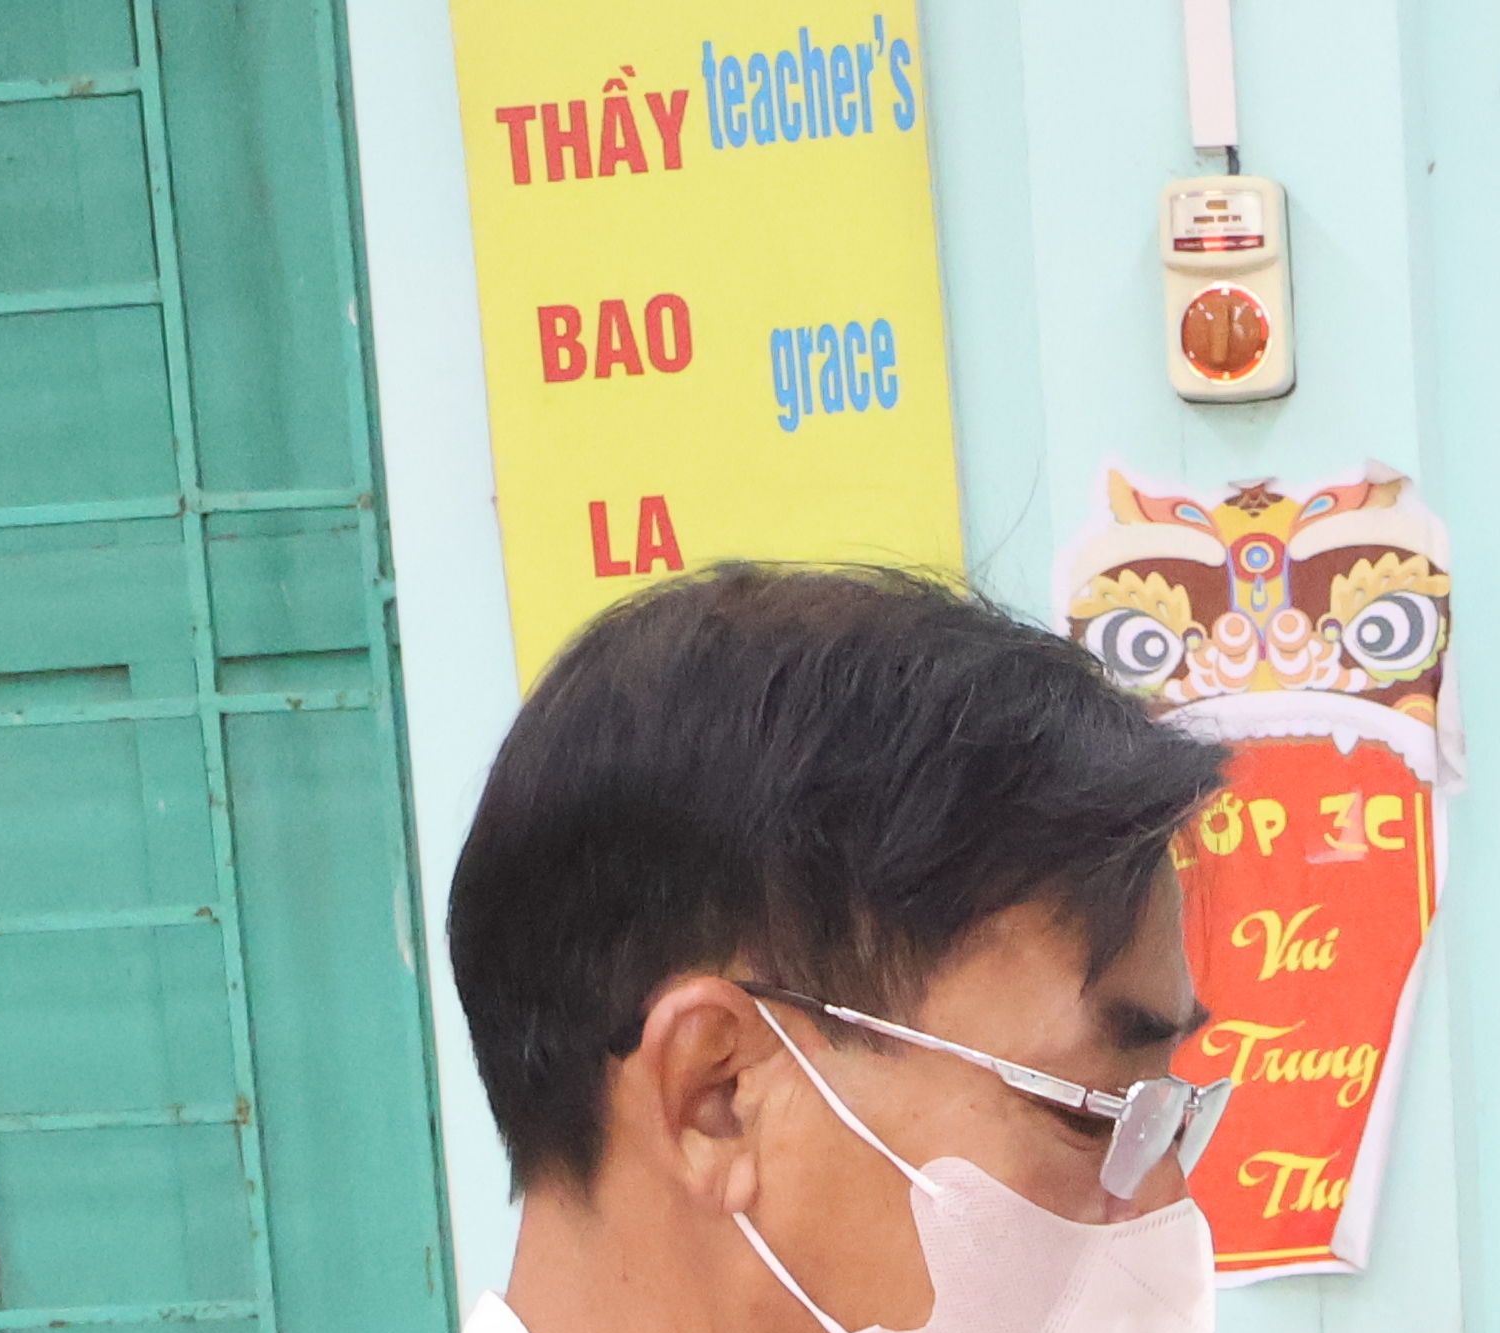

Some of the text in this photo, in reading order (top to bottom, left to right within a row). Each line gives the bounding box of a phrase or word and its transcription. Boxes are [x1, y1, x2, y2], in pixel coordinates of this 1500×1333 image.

[496, 65, 689, 185] THẦY
[701, 14, 916, 150] teacher's
[537, 293, 693, 383] BAO
[770, 318, 900, 432] grace
[589, 495, 684, 577] LA
[1319, 794, 1406, 852] 3C
[1231, 904, 1340, 982] Vui
[1201, 1020, 1379, 1107] Trung
